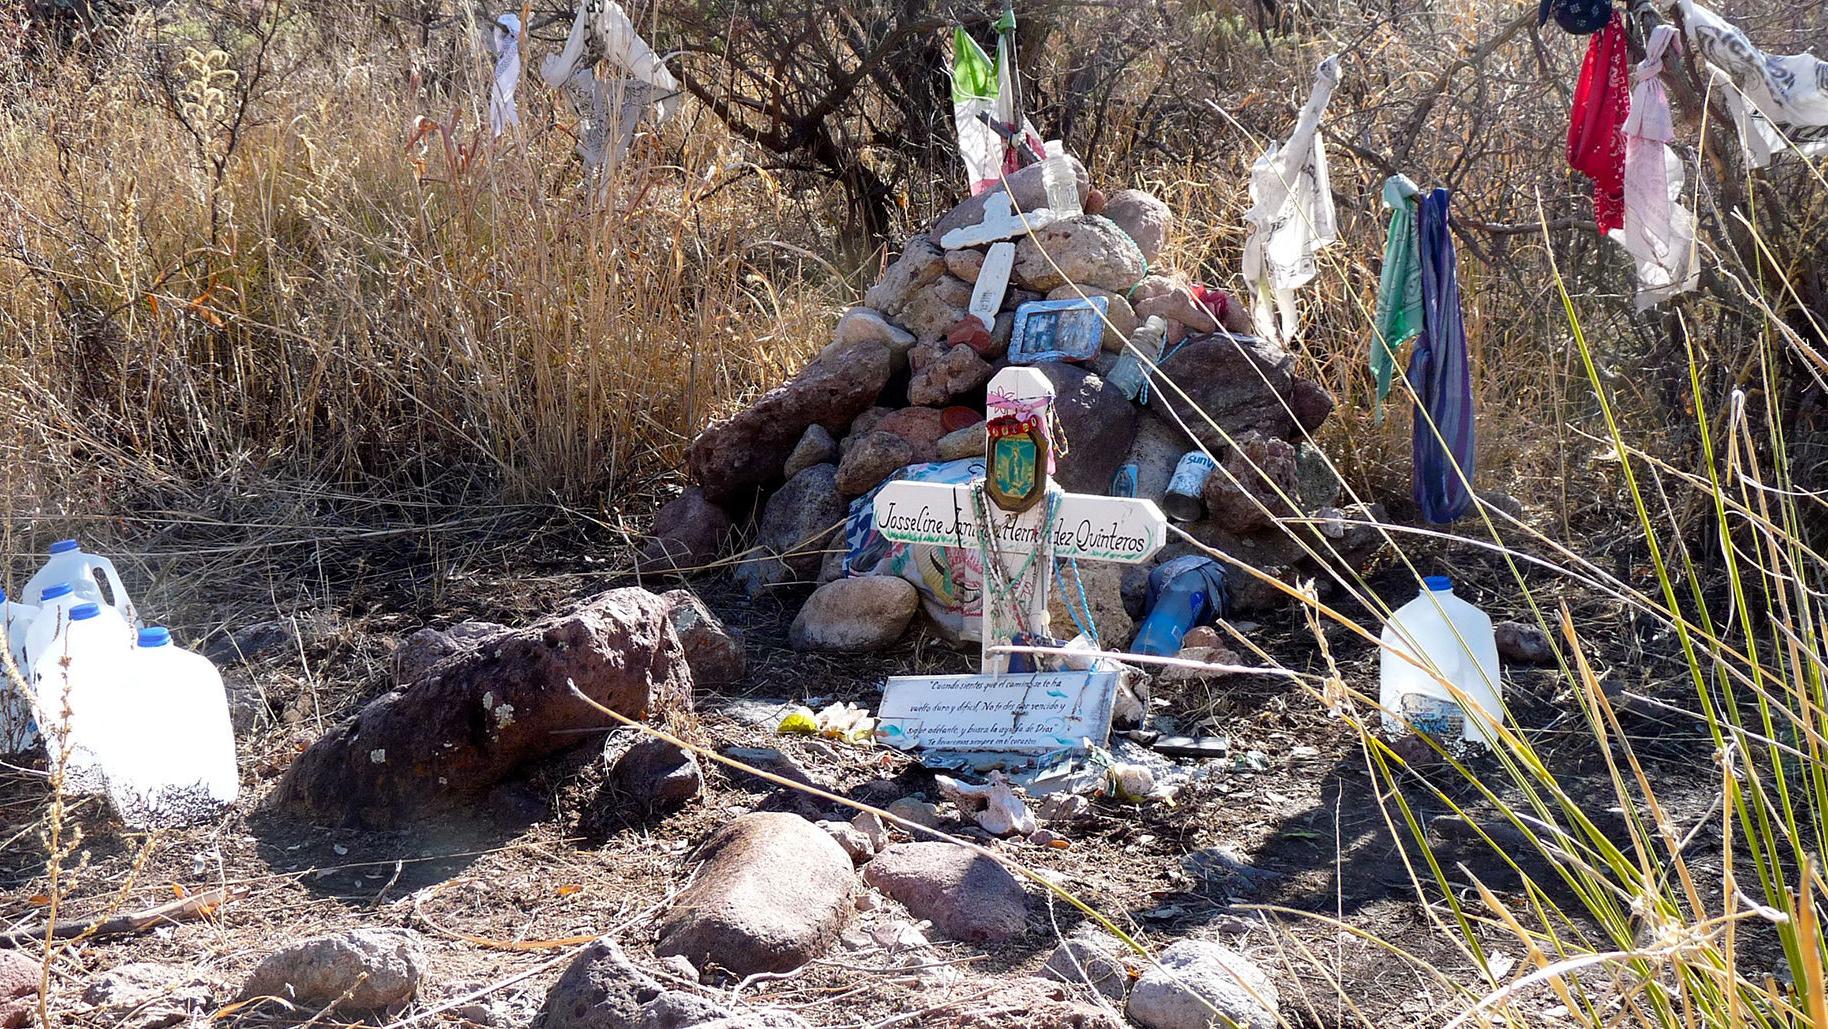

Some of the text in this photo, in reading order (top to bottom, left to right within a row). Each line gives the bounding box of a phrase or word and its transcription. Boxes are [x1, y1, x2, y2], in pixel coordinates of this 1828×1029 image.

[878, 502, 944, 533] Josseline
[1002, 513, 1074, 546] Herndez
[1076, 519, 1145, 552] Quinteros
[983, 683, 998, 692] que
[1050, 677, 1062, 688] ha
[932, 701, 949, 711] duro
[982, 702, 994, 711] No
[1030, 700, 1058, 710] vencido
[966, 723, 989, 734] busca
[990, 723, 998, 733] la
[928, 738, 936, 746] Te
